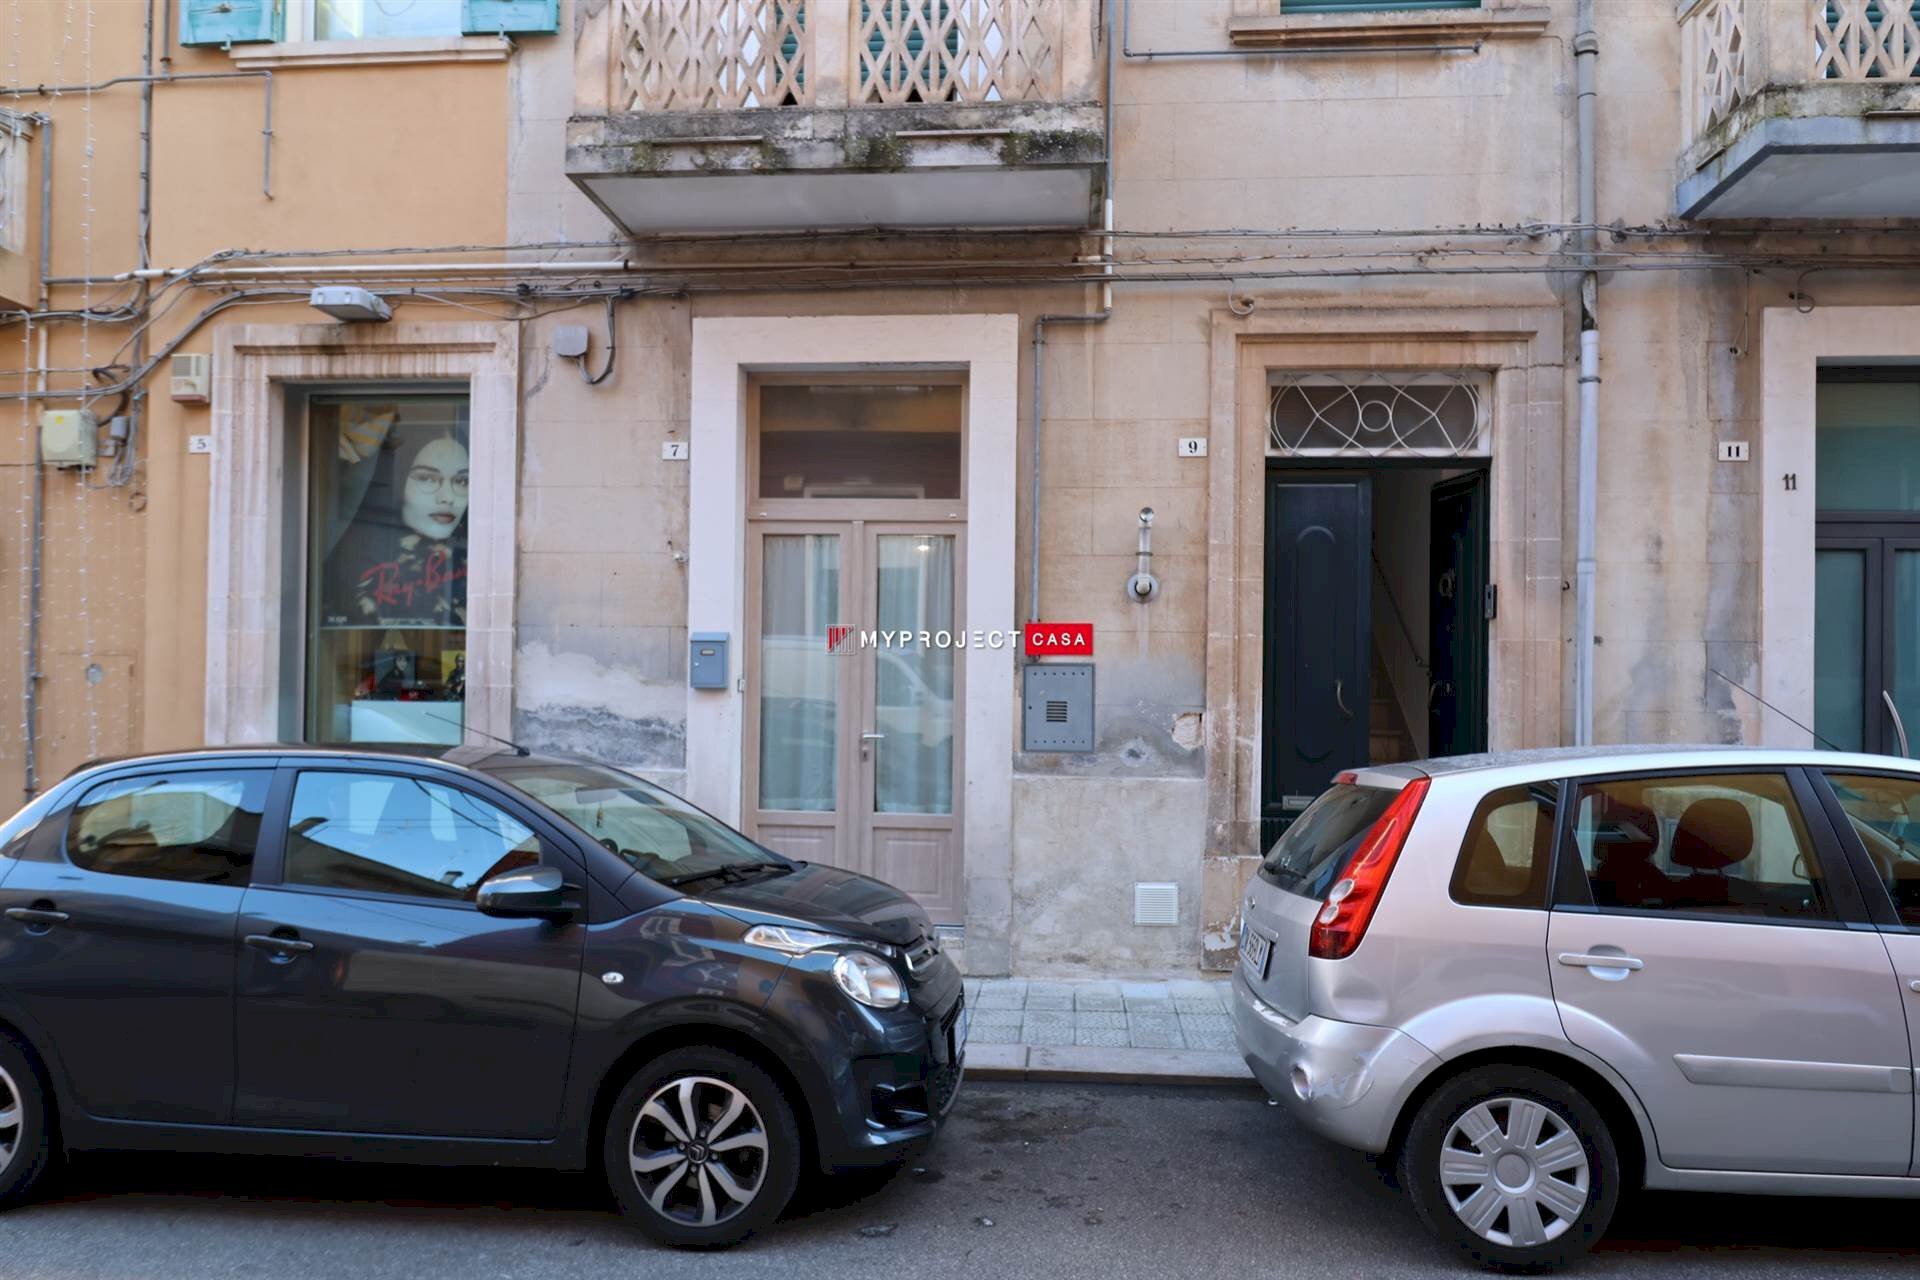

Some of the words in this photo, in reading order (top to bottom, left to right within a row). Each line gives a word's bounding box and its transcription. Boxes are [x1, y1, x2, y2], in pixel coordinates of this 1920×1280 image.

[197, 437, 206, 450] 5
[1188, 440, 1198, 454] 9
[671, 444, 680, 457] 7
[1727, 445, 1740, 458] 11
[1782, 473, 1797, 491] 11
